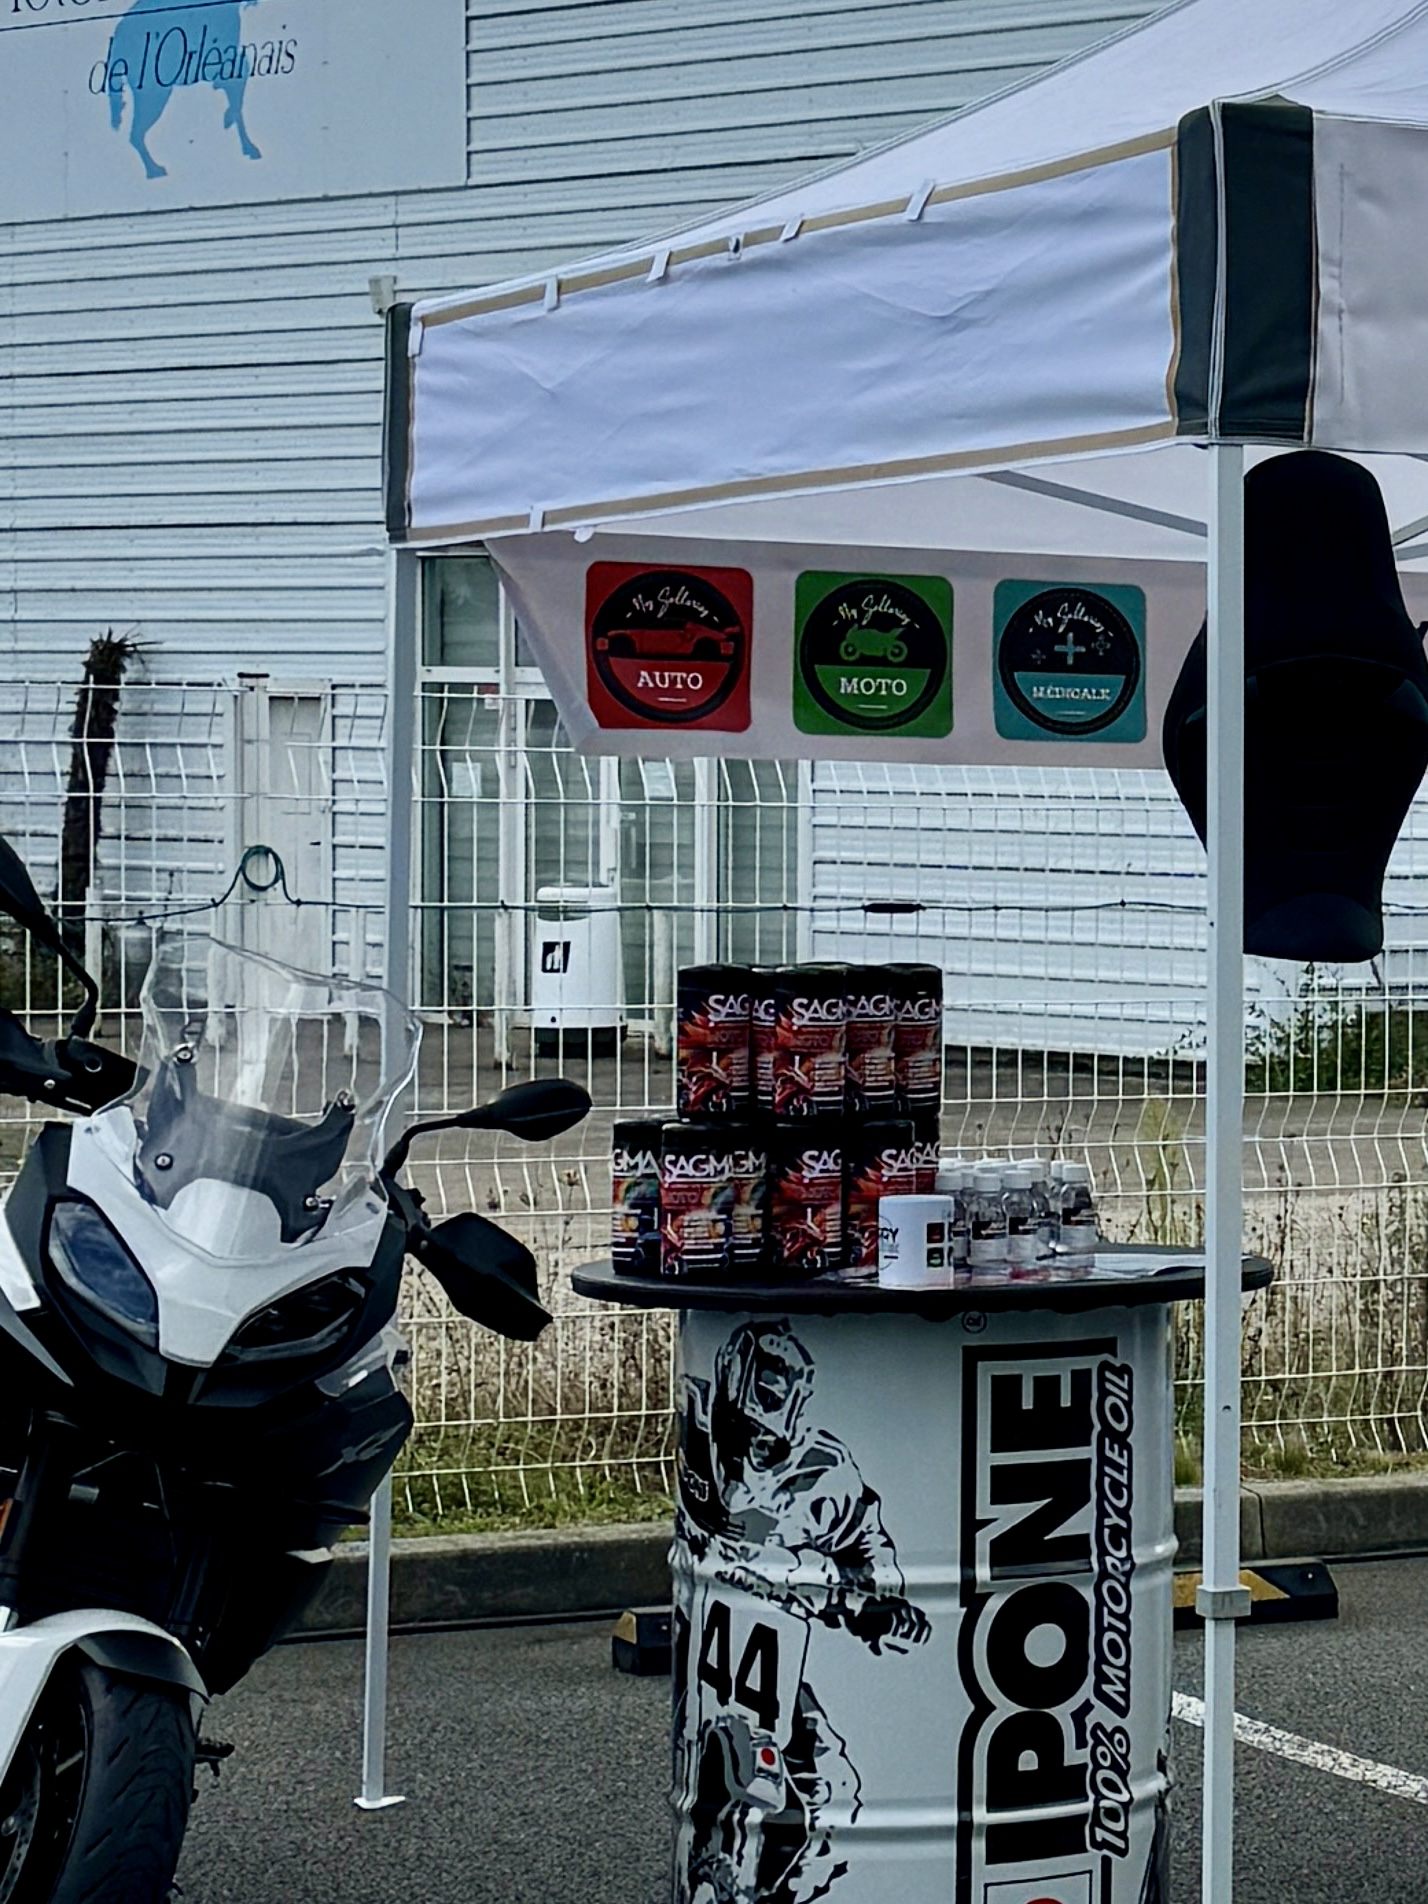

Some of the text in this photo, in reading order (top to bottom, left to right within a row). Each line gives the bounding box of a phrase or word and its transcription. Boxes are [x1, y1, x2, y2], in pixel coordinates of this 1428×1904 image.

[88, 36, 128, 95] de
[636, 670, 703, 690] AUTO
[839, 676, 908, 696] MOTO
[985, 1367, 1093, 1866] IPONE
[1094, 1370, 1131, 1849] 100% MOTORCYCLE OIL
